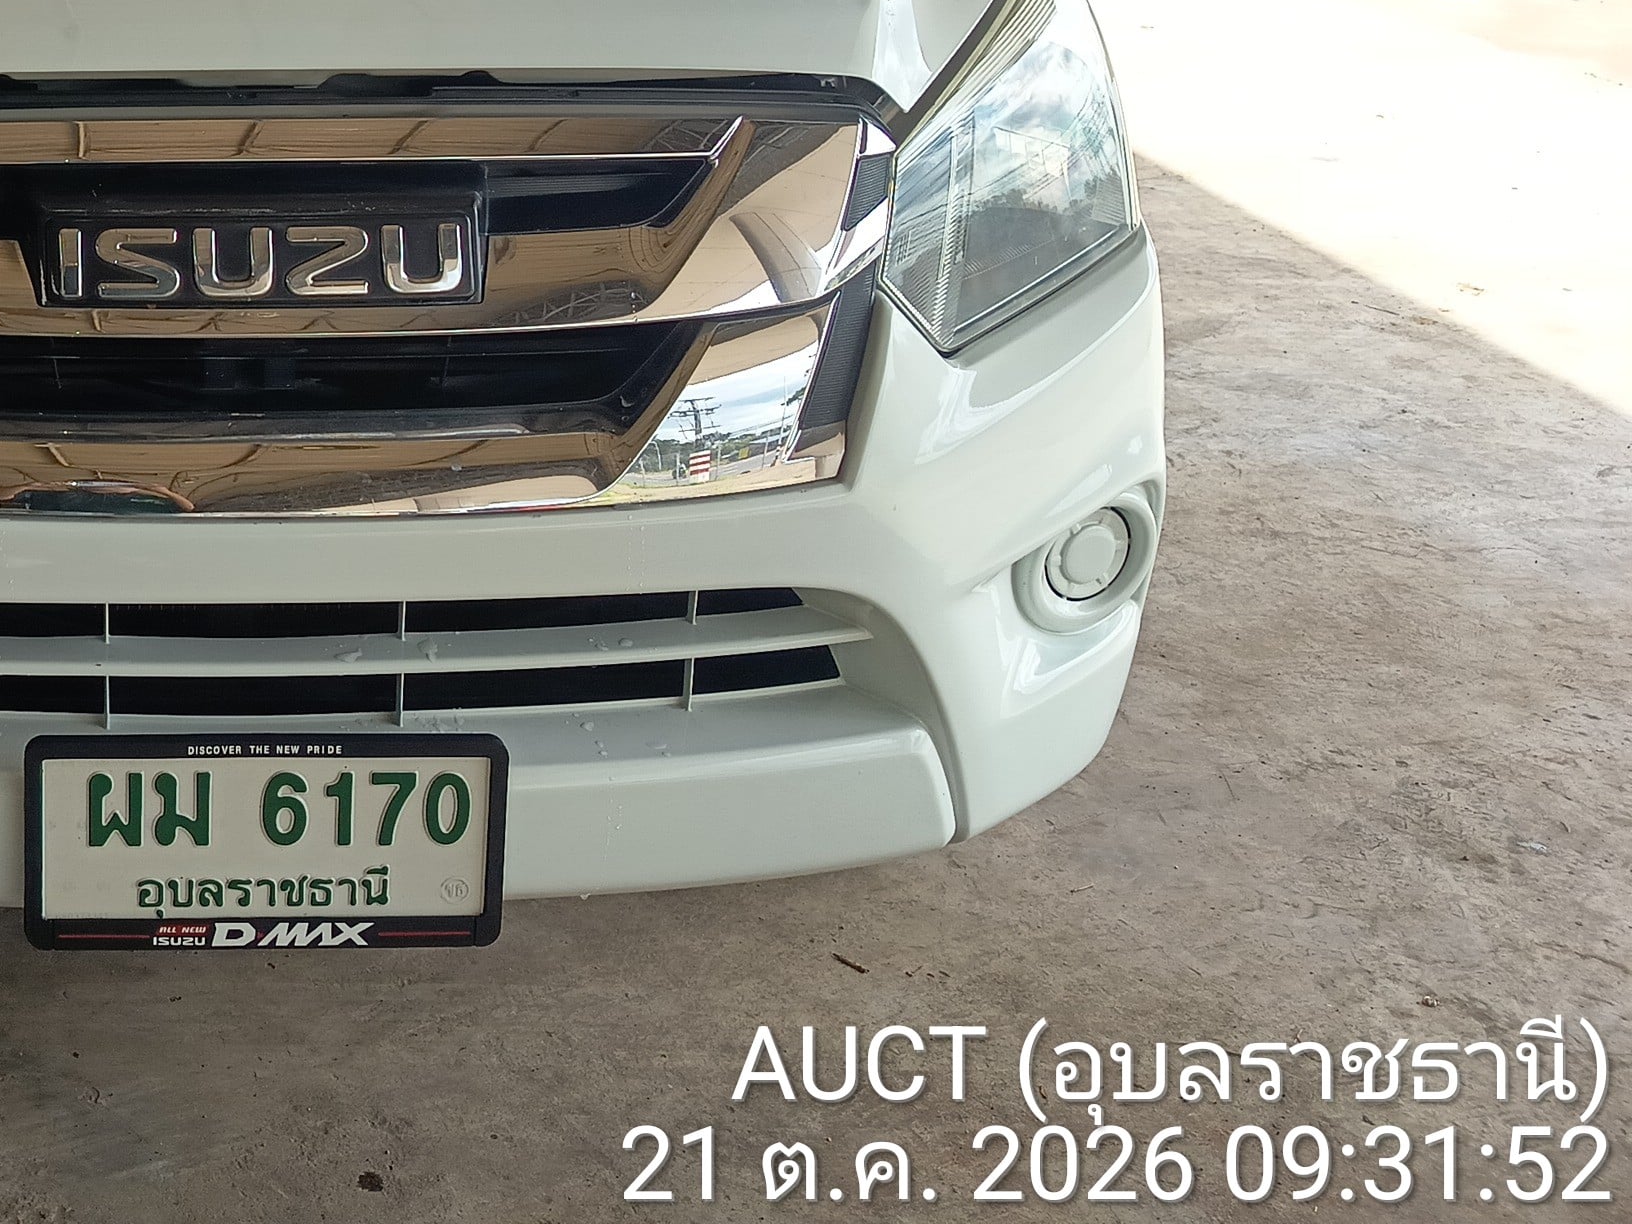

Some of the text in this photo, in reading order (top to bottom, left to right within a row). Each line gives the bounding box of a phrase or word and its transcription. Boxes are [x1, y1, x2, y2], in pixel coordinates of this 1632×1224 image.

[58, 223, 464, 299] ISUZU
[187, 745, 343, 755] DISCOVER THE NEW PRIDE
[86, 769, 472, 848] ผม 6170
[136, 865, 391, 918] อุบลราชธานี
[152, 936, 206, 946] ISUZU
[159, 926, 207, 934] ALL NEW
